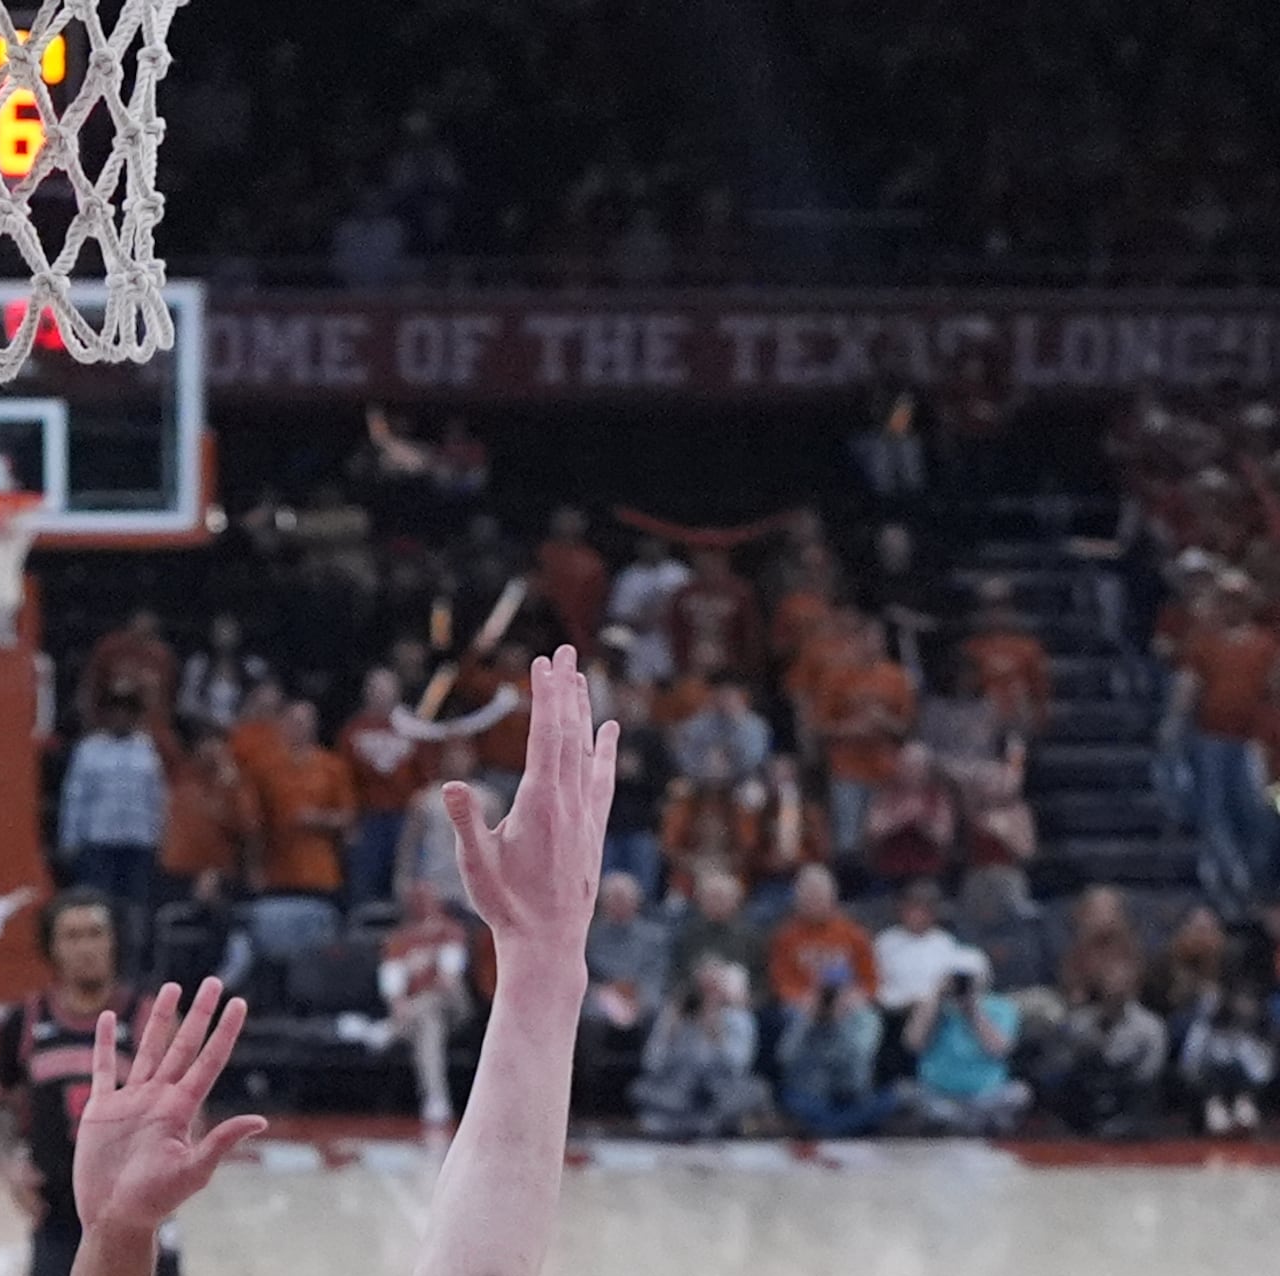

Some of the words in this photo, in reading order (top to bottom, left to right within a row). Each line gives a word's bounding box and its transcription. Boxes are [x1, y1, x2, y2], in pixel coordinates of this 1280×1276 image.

[206, 312, 370, 386] OME
[397, 313, 498, 385] OF
[524, 314, 692, 385] THE
